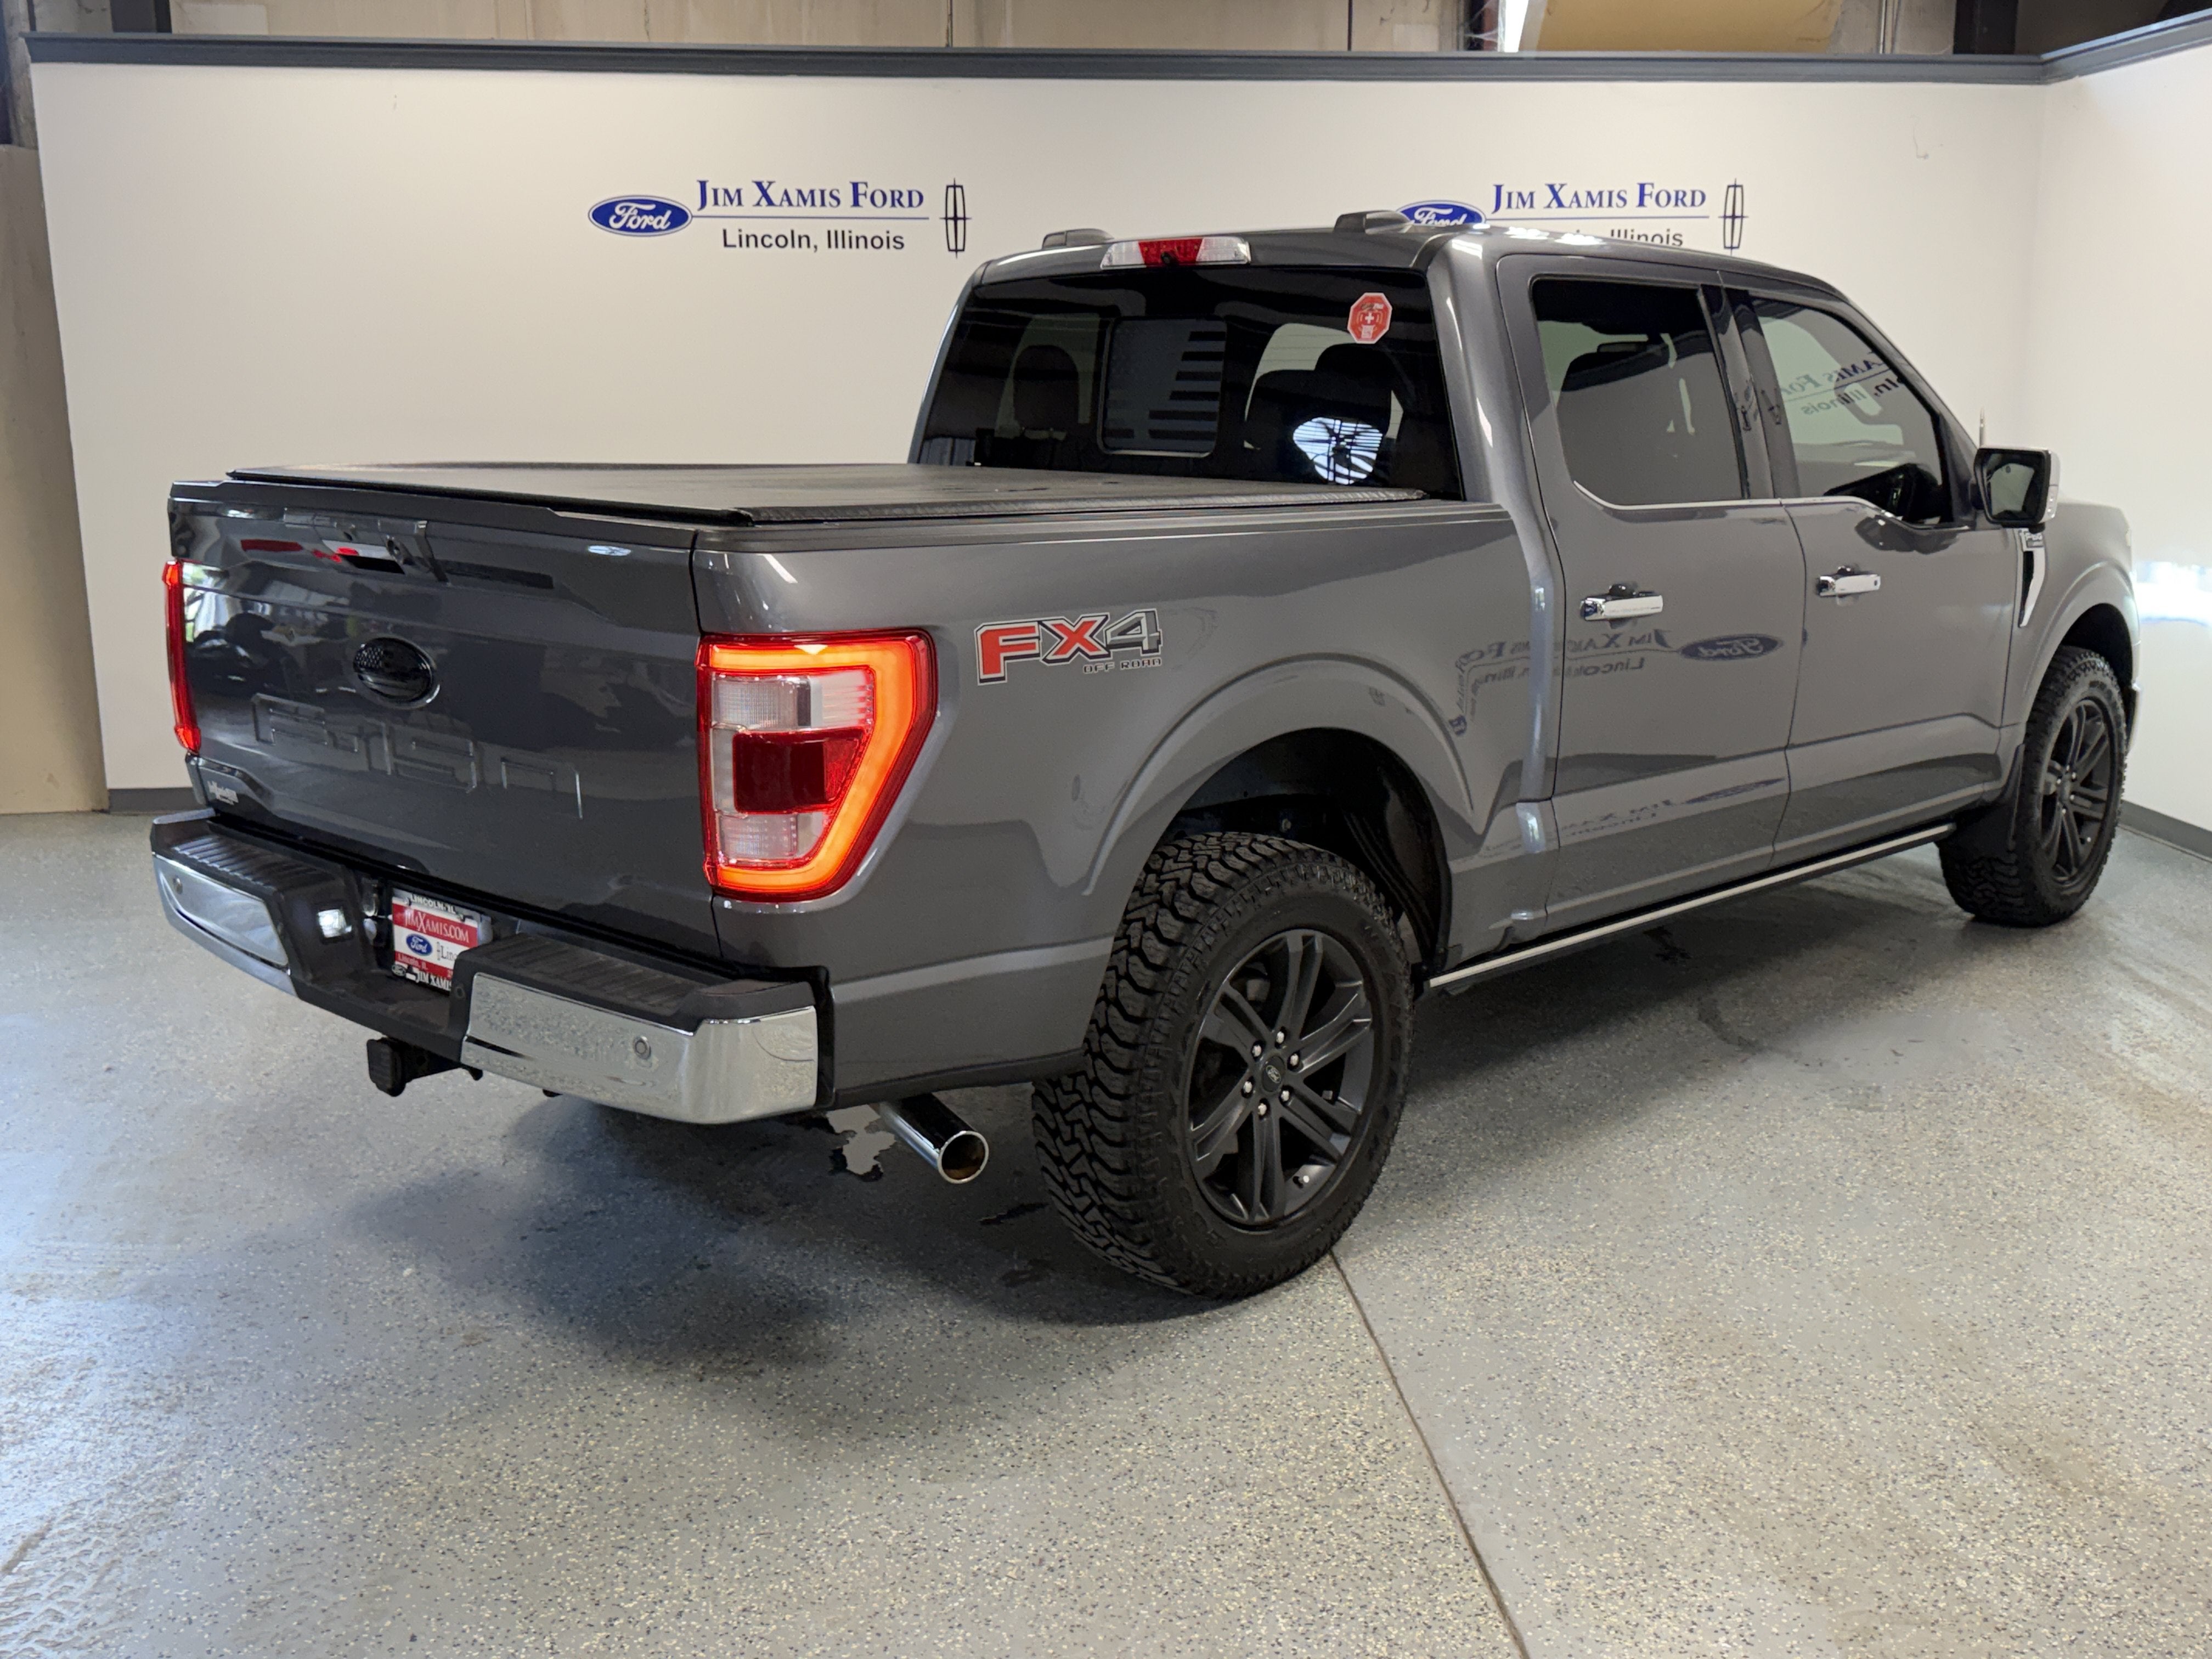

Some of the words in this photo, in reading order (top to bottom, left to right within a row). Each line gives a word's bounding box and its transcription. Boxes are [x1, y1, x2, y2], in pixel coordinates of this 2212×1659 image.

[609, 202, 672, 230] Ford
[722, 228, 819, 253] Lincoln,
[827, 229, 905, 250] Illinois
[973, 608, 1163, 686] FX4
[1082, 661, 1115, 674] OFF
[1119, 657, 1163, 670] ROAD
